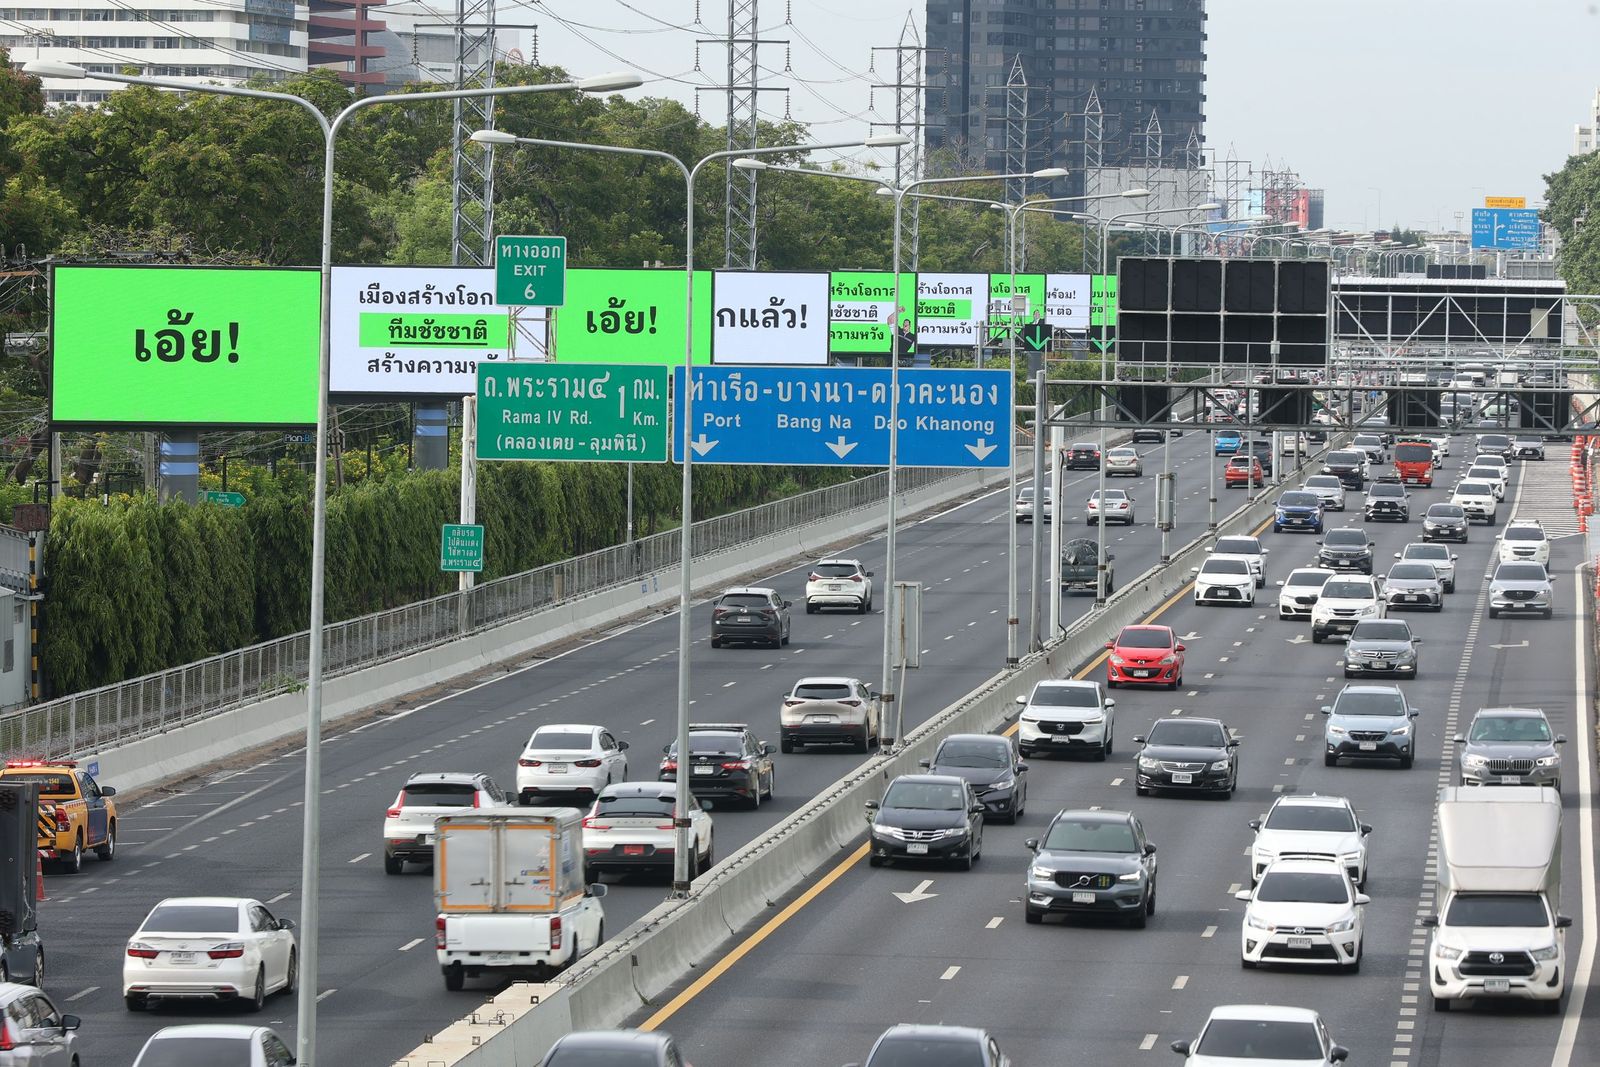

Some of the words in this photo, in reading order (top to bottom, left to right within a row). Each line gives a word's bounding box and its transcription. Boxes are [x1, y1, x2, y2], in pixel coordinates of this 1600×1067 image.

[501, 244, 561, 259] ทางออก
[513, 264, 547, 277] EXIT
[524, 283, 536, 300] 6
[586, 296, 658, 334] เอ้ย!
[716, 296, 808, 329] กแล้ว!
[830, 304, 878, 318] ชัชชาติ
[135, 307, 241, 365] เอ้ย!
[388, 317, 488, 340] ทีมชัชชาติ
[633, 378, 660, 400] กม.
[618, 385, 626, 419] 1
[502, 409, 541, 424] Rama
[547, 410, 562, 424] IV
[570, 410, 592, 425] Rd.
[633, 411, 659, 426] Km.
[703, 412, 741, 427] Port
[777, 414, 822, 433] Bang
[830, 414, 852, 429] Na
[916, 416, 995, 435] Khanong
